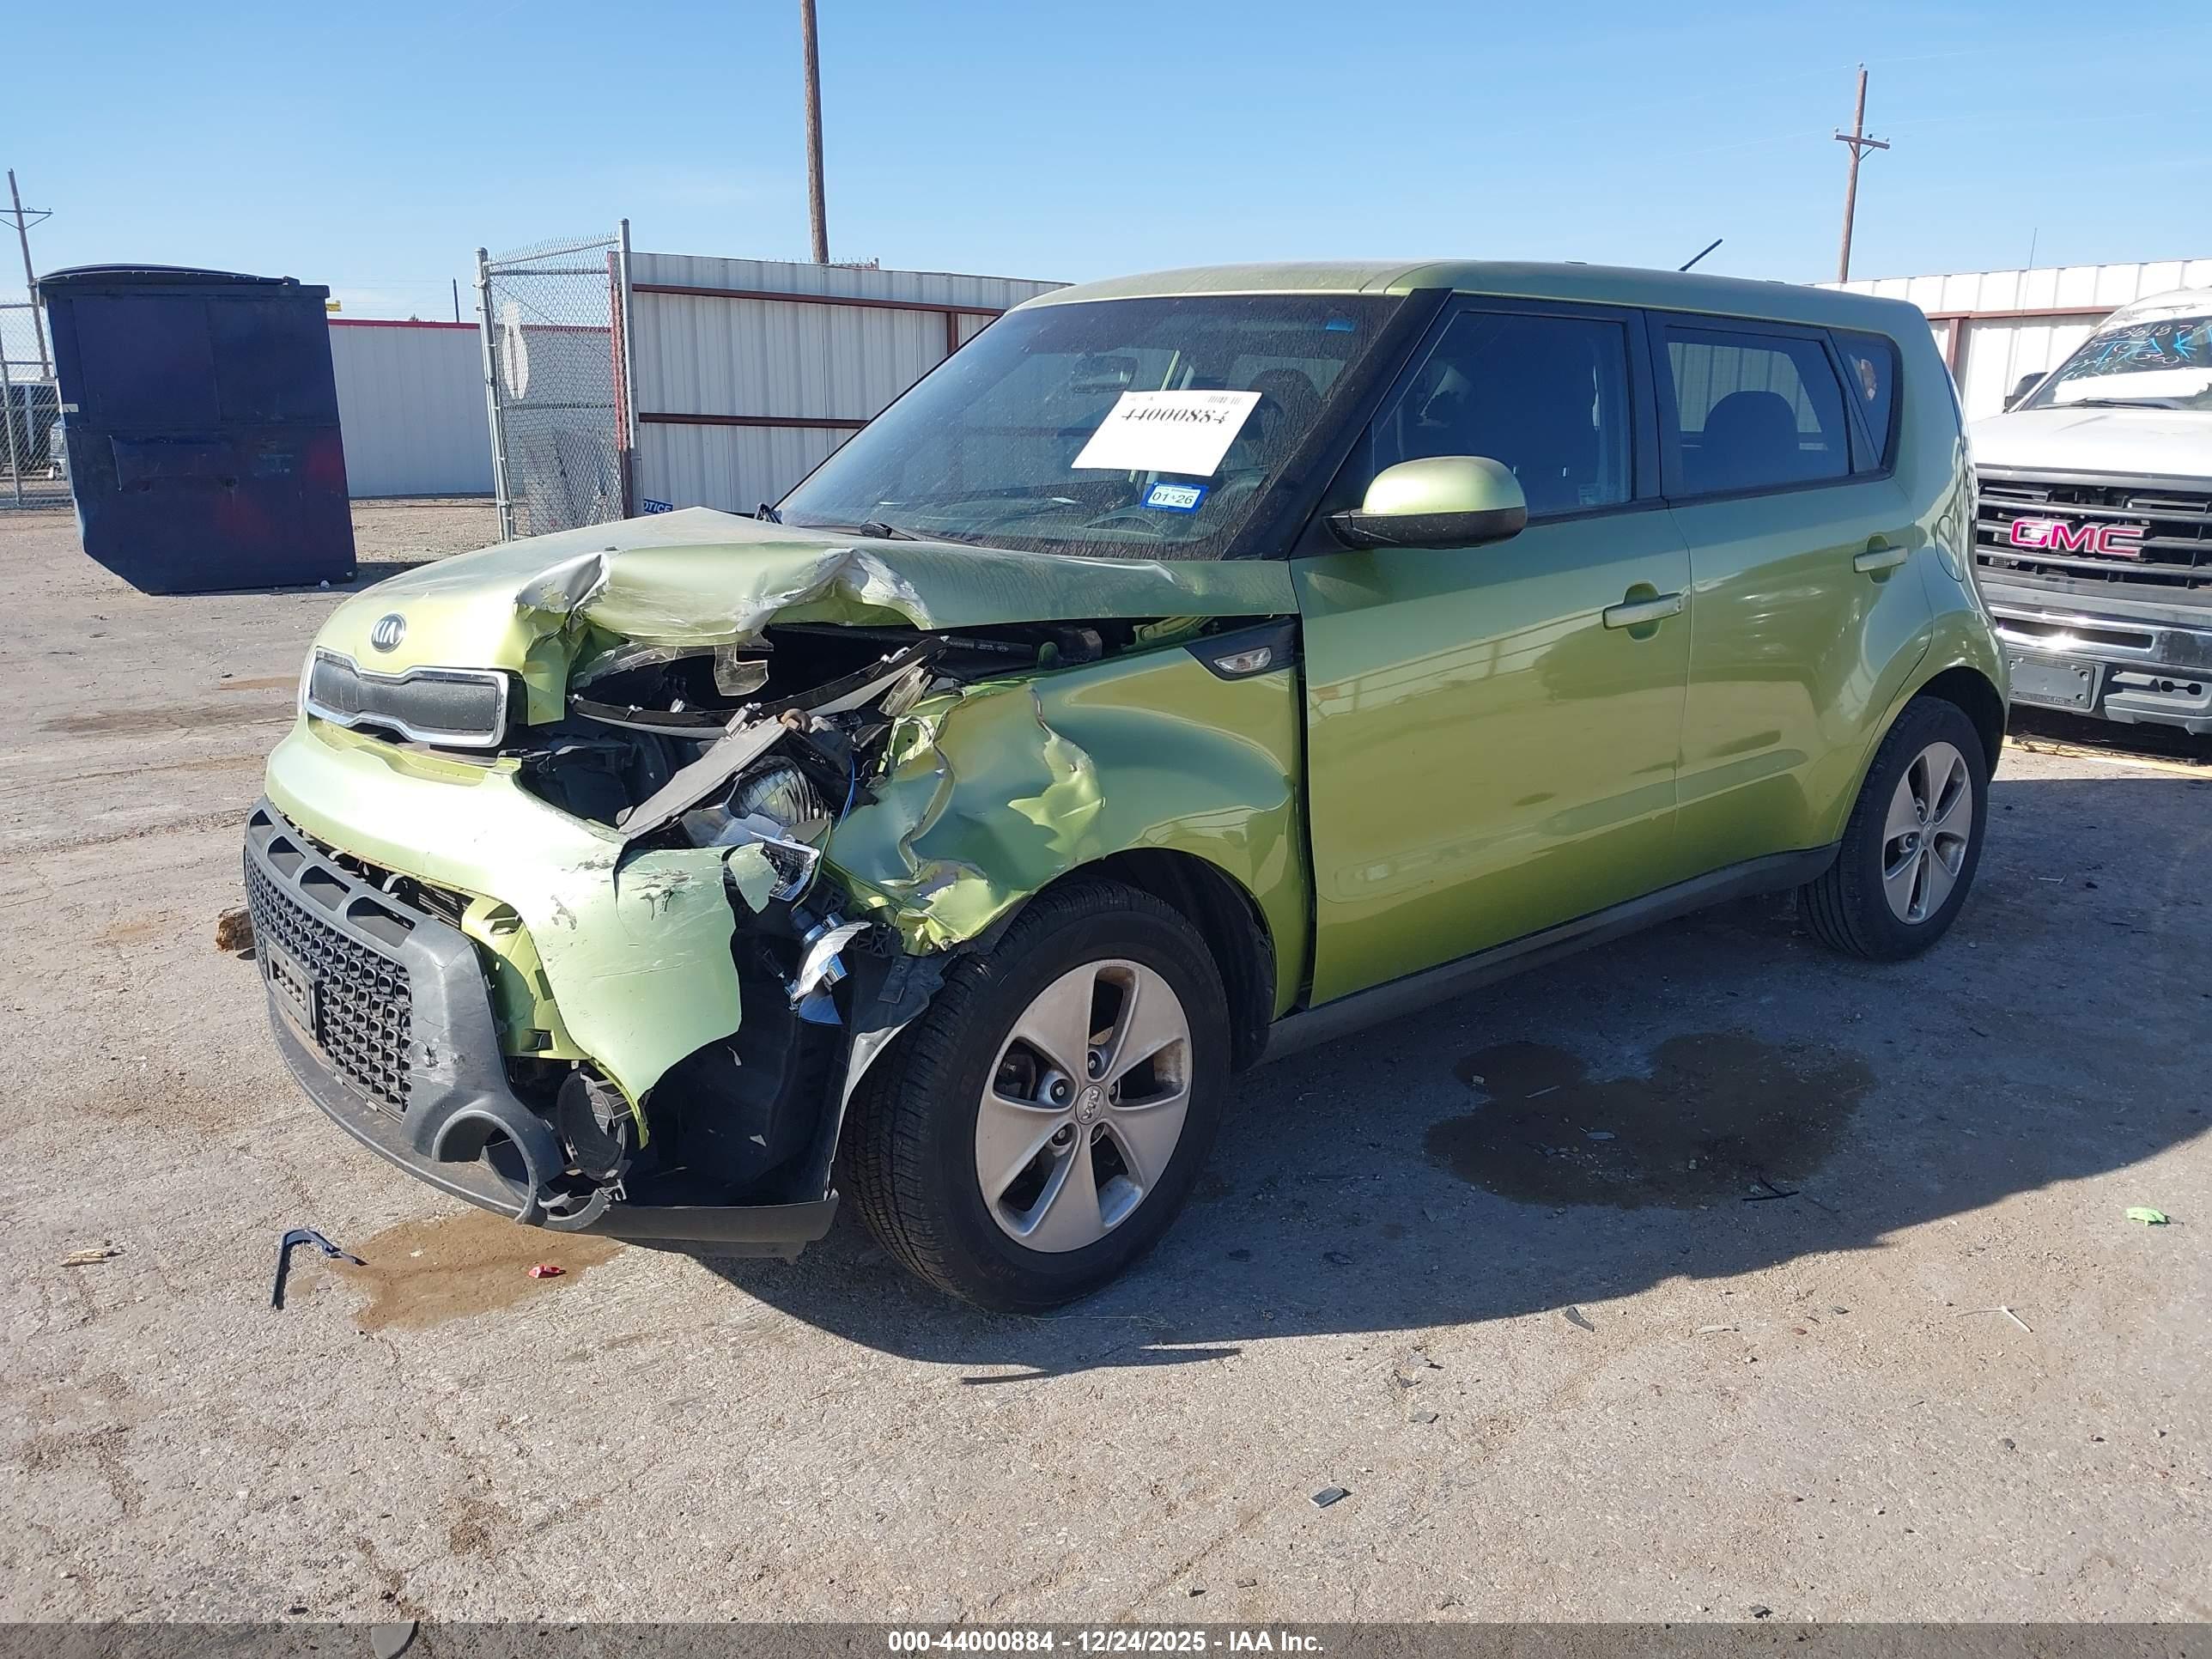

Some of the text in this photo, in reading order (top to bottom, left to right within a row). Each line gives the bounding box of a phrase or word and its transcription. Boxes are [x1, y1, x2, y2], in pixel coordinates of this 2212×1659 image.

[644, 501, 672, 513] OTICE
[1175, 494, 1194, 505] 26
[2010, 519, 2143, 557] GMC
[373, 621, 397, 644] KIA
